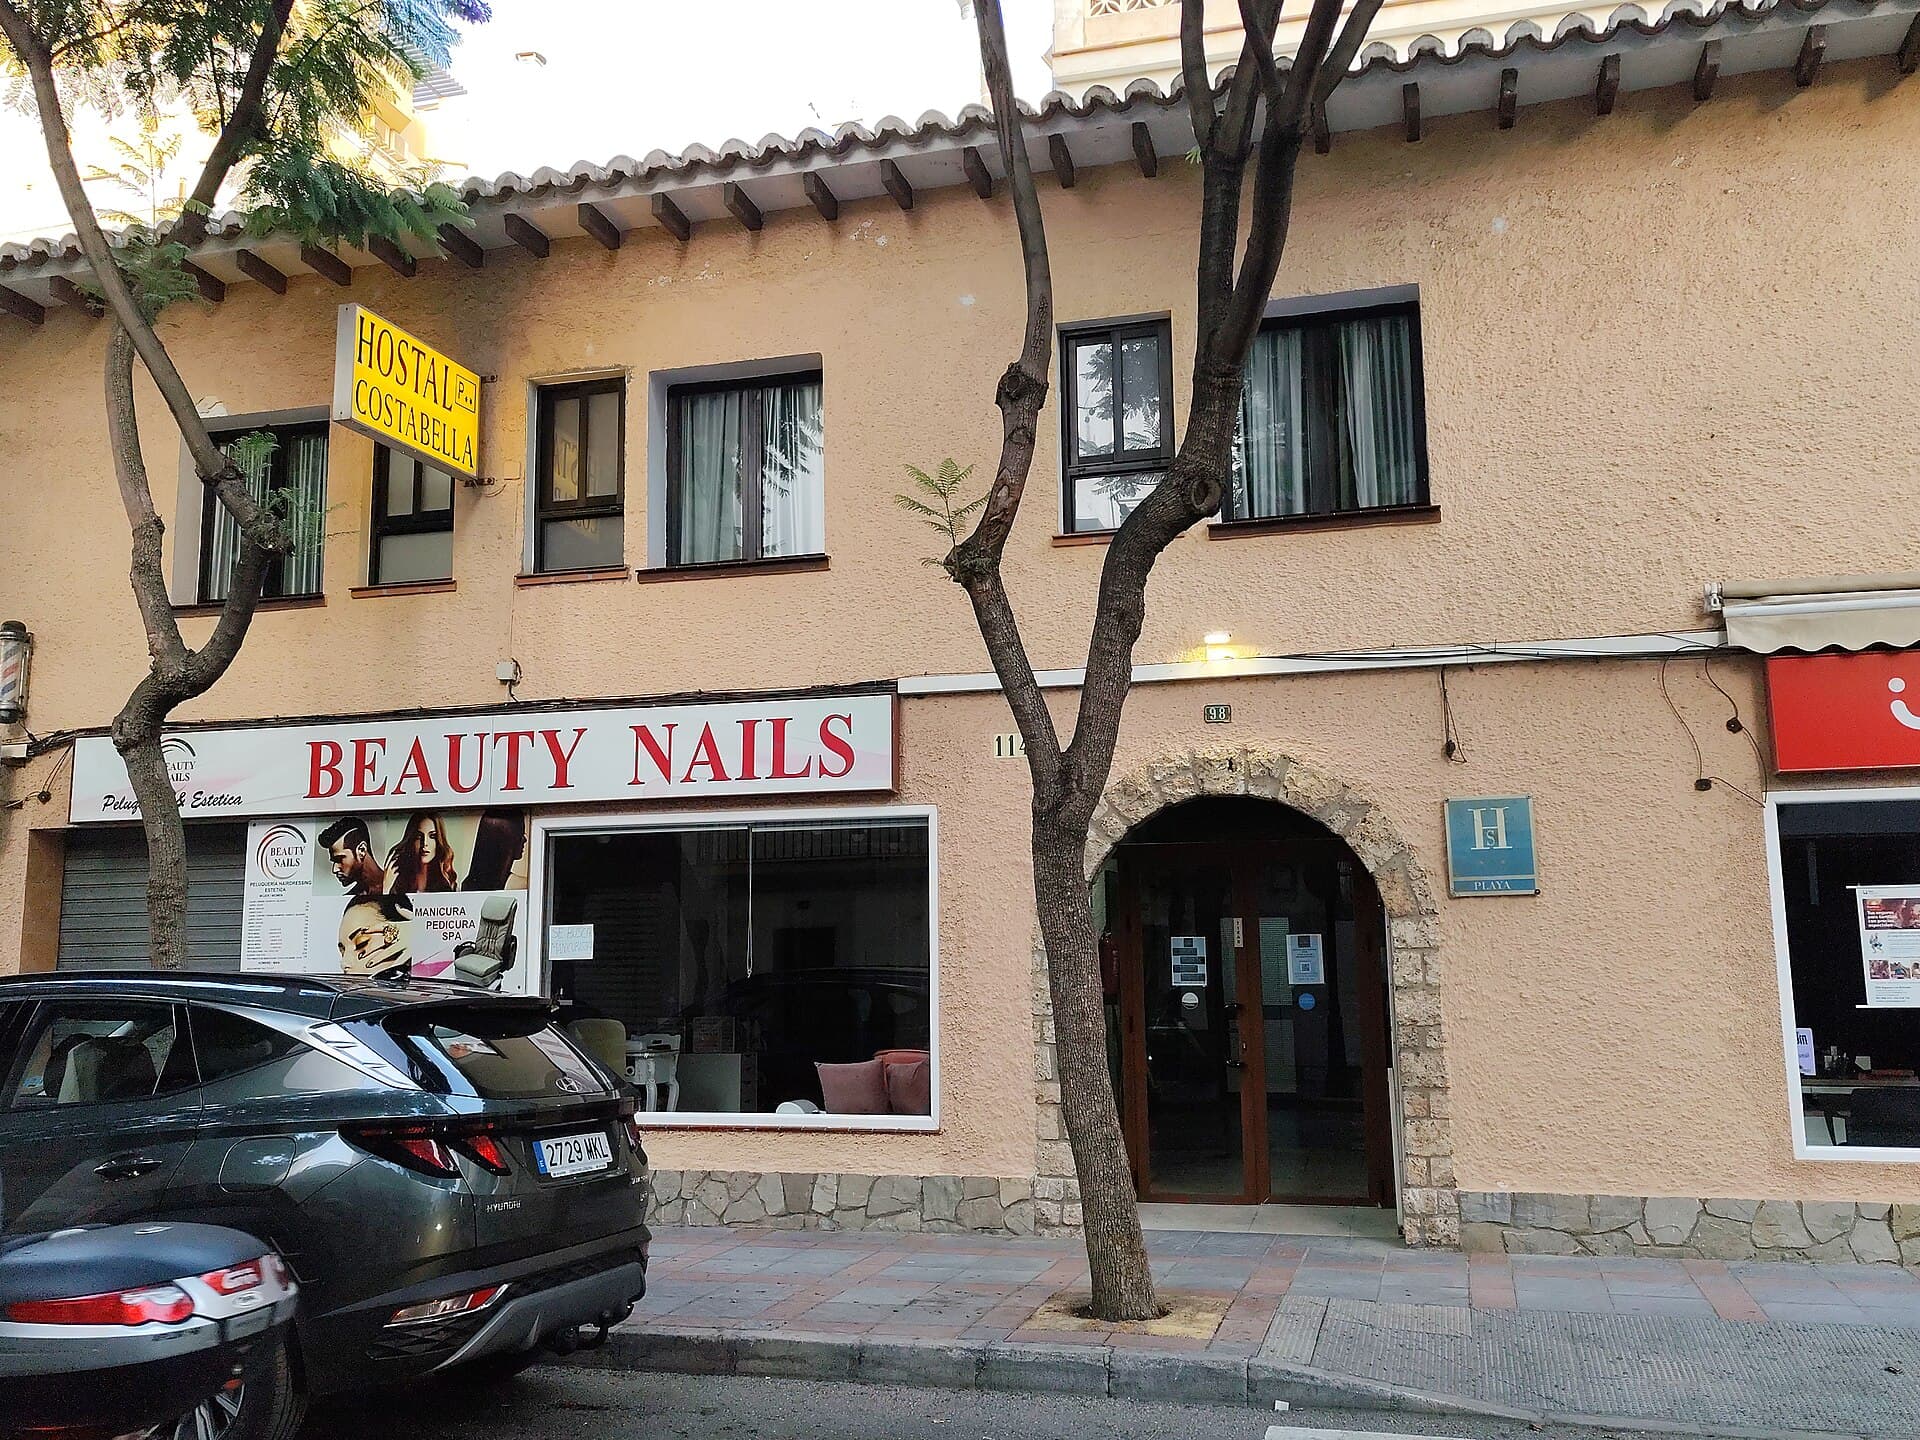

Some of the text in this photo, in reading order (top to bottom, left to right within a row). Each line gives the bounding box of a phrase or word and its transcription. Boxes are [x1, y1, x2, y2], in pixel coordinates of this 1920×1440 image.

[357, 315, 453, 412] HOSTAL
[355, 379, 474, 469] COSTABELLA
[1209, 706, 1226, 720] 98
[303, 713, 856, 799] BEAUTY NAILS
[165, 761, 196, 772] EAUTY
[169, 773, 190, 782] AILS
[176, 791, 187, 808] &
[190, 791, 243, 808] Estetica
[270, 845, 306, 857] BEAUTY
[273, 857, 301, 868] NAILS
[1474, 880, 1512, 891] PLAYA
[414, 906, 467, 917] MANICURA
[426, 920, 476, 930] PEDICURA
[442, 931, 462, 941] SPA
[545, 1136, 609, 1167] 2729 MKL
[486, 1200, 521, 1213] HYUNDAI
